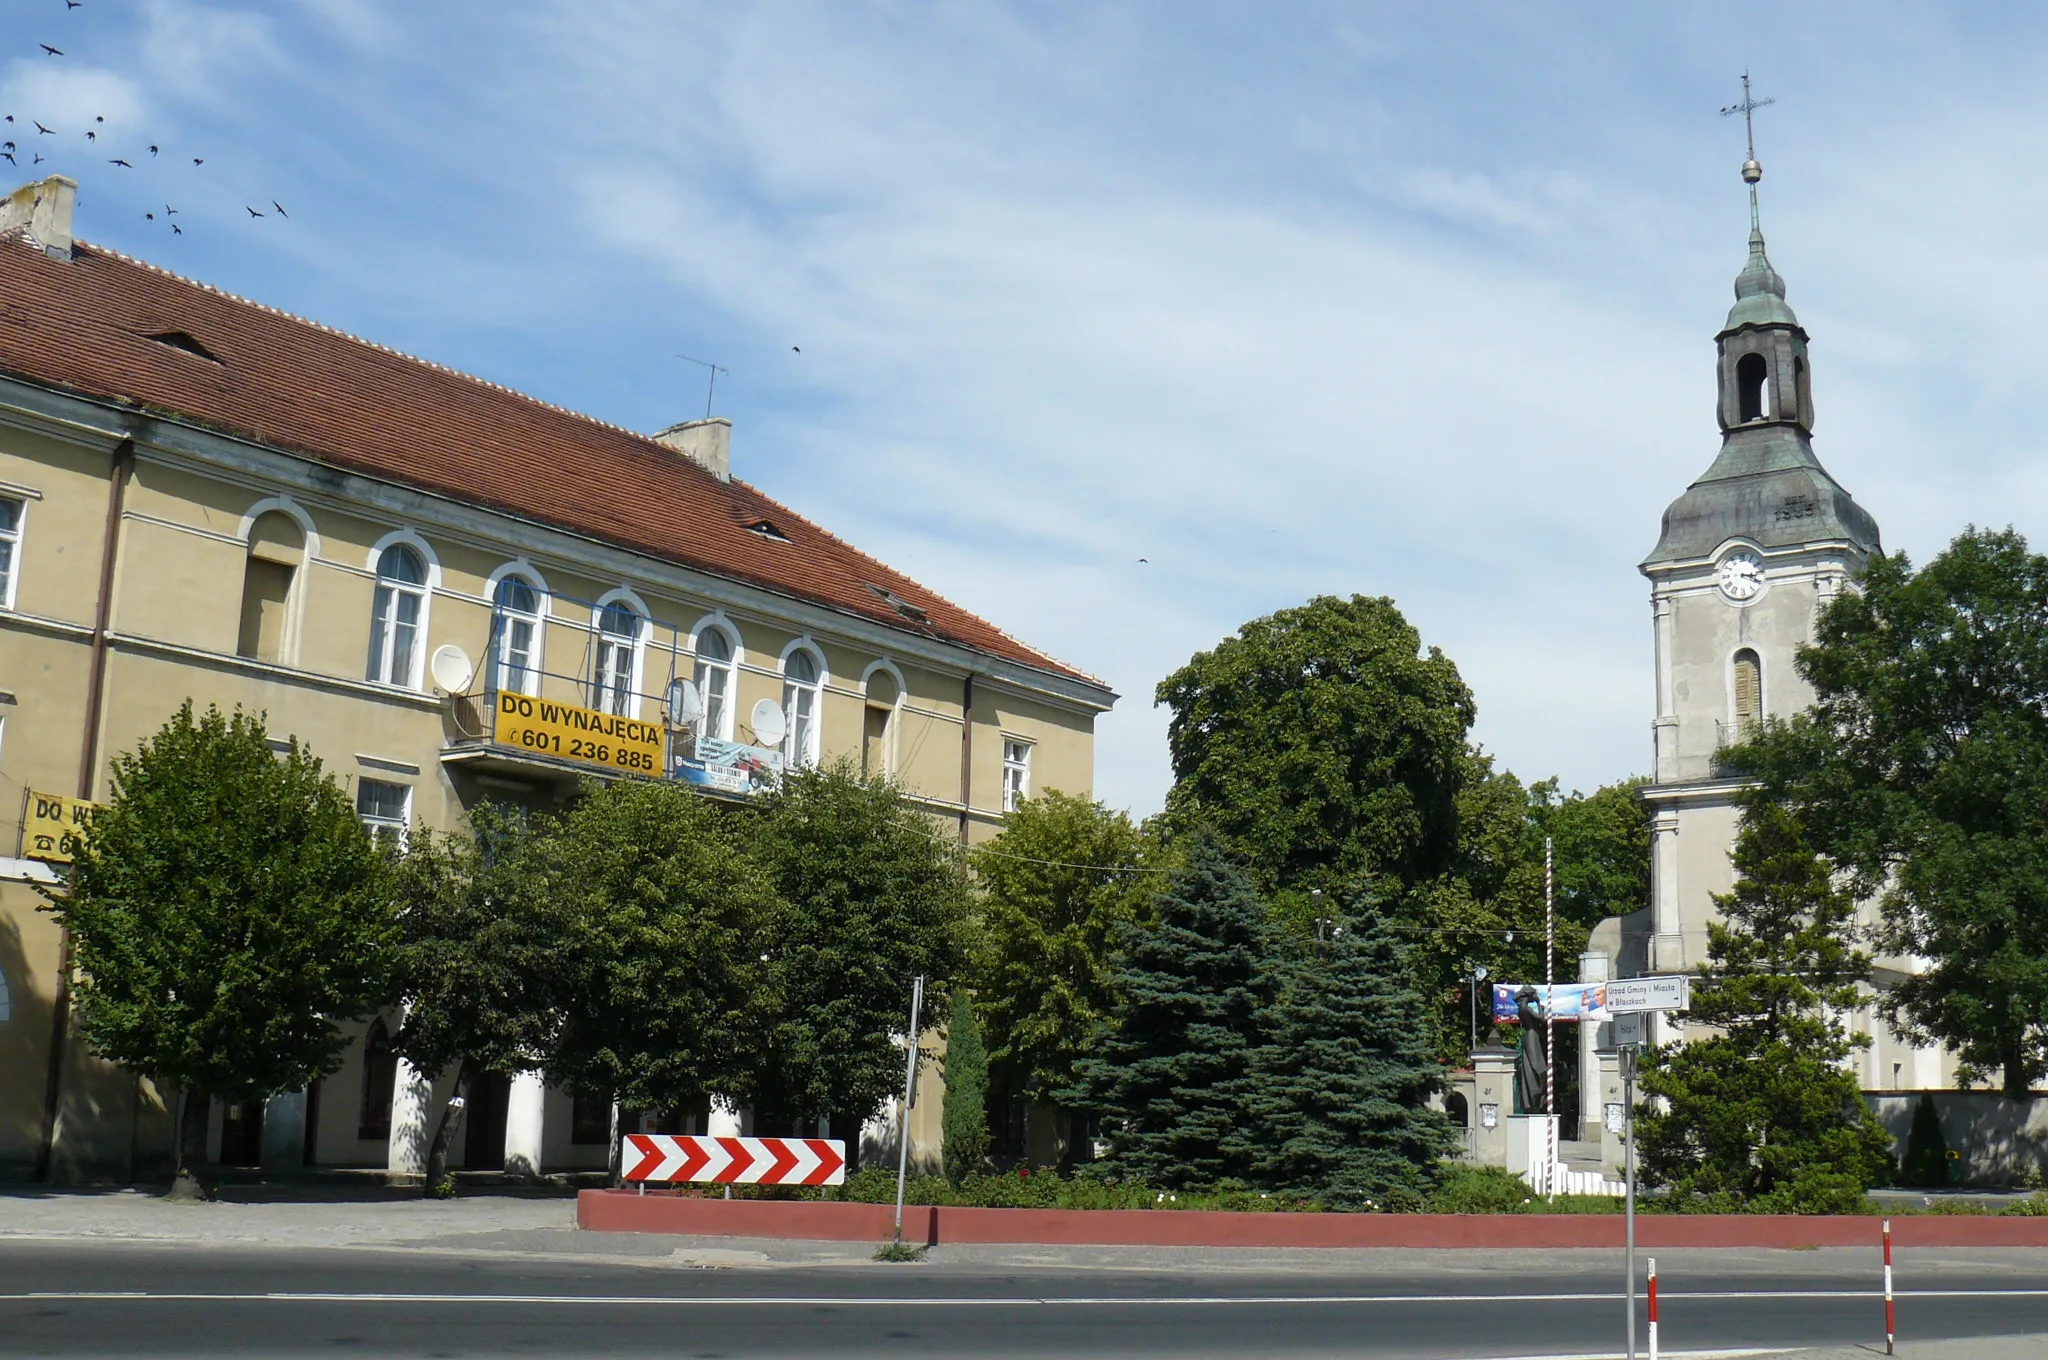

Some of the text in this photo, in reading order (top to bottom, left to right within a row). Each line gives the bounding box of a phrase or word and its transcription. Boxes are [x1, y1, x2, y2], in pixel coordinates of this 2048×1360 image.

[502, 695, 660, 745] DO WYNAJĘCIA
[522, 729, 653, 770] 601 236 885
[36, 799, 62, 820] DO
[1627, 985, 1647, 994] Gminy
[1653, 984, 1675, 992] Miasta
